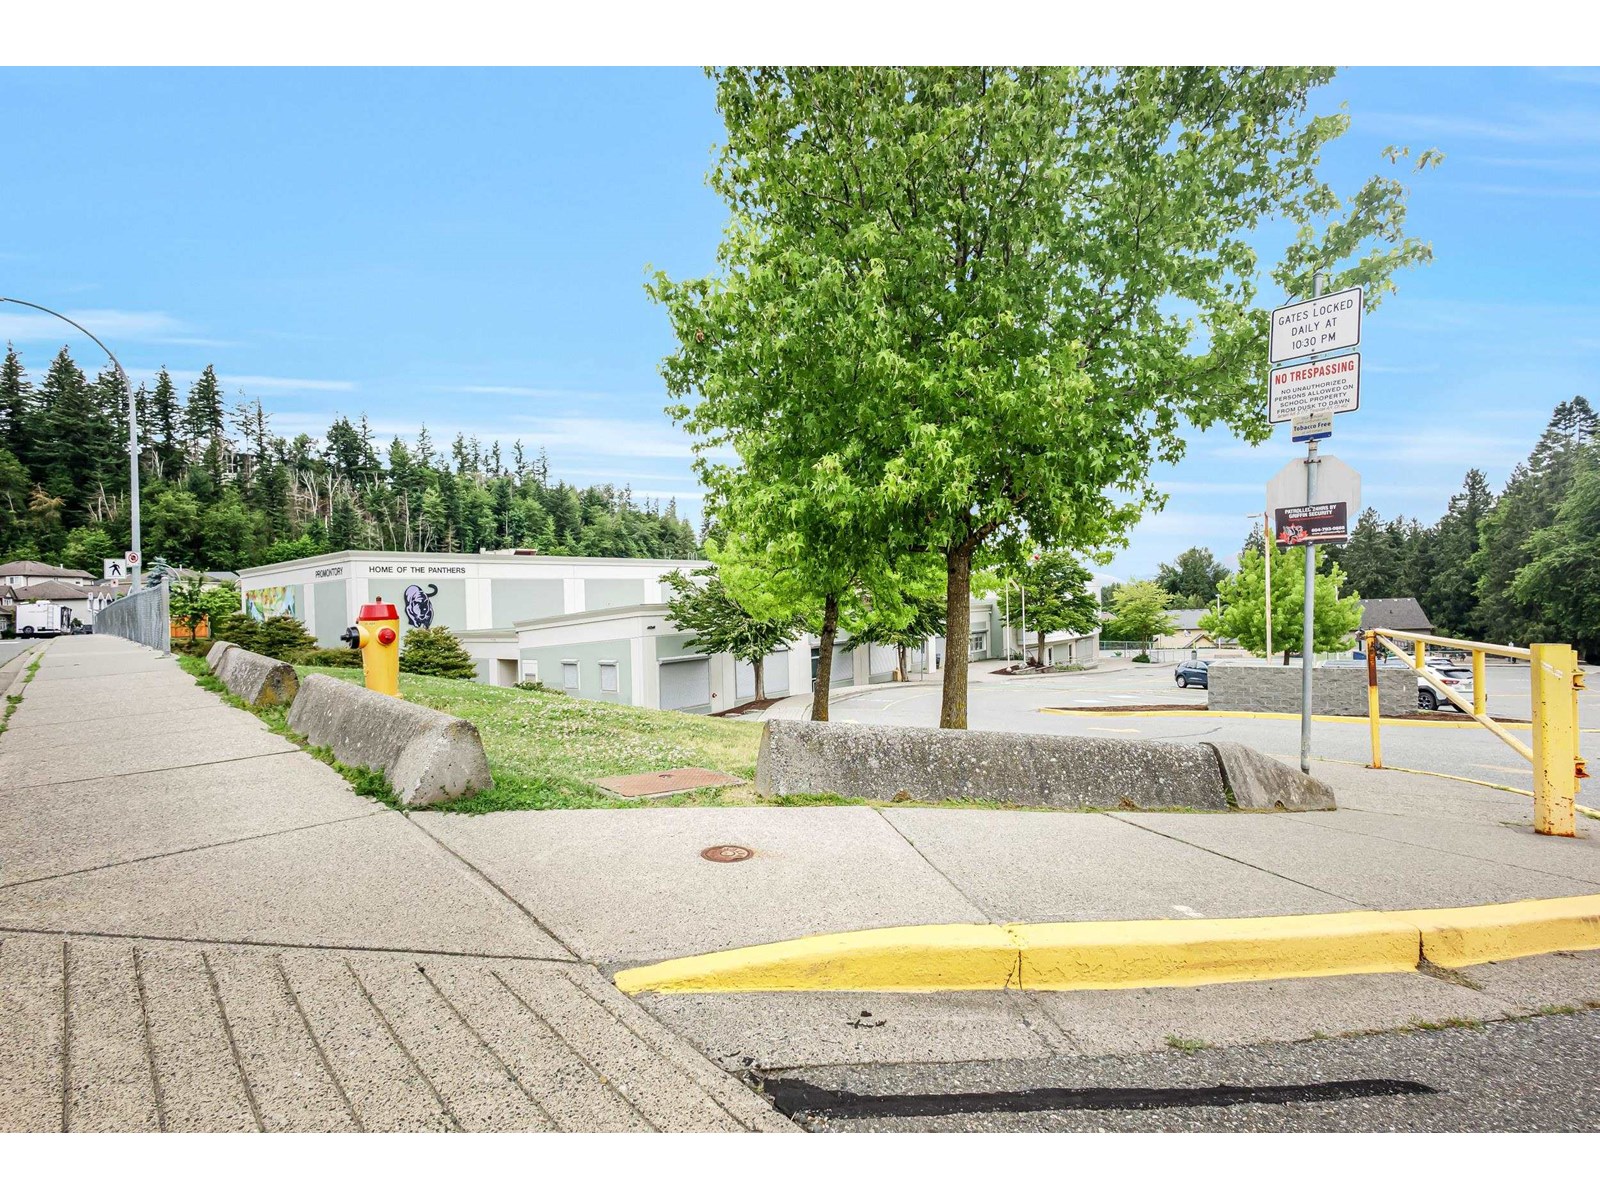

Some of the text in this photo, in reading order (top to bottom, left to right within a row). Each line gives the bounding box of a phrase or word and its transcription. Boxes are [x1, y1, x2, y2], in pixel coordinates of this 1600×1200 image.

[1278, 299, 1353, 325] GATES LOCKED
[1291, 317, 1337, 336] DAILY AT
[1292, 332, 1336, 350] 10:30 PM
[1275, 360, 1354, 385] NO TRESPASSING
[1274, 392, 1306, 402] PERSONS
[1307, 386, 1341, 397] ALLOWED
[1292, 378, 1347, 393] UNAUTHORIZED
[1276, 406, 1296, 415] FROM
[1297, 402, 1316, 411] DUSK
[1329, 397, 1350, 406] DAWN
[1280, 391, 1347, 408] SCHOOL PROPERTY
[1293, 424, 1317, 432] Tobacco
[315, 566, 344, 578] PROMONTORY
[368, 566, 466, 574] HOME OF THE PANTHERS
